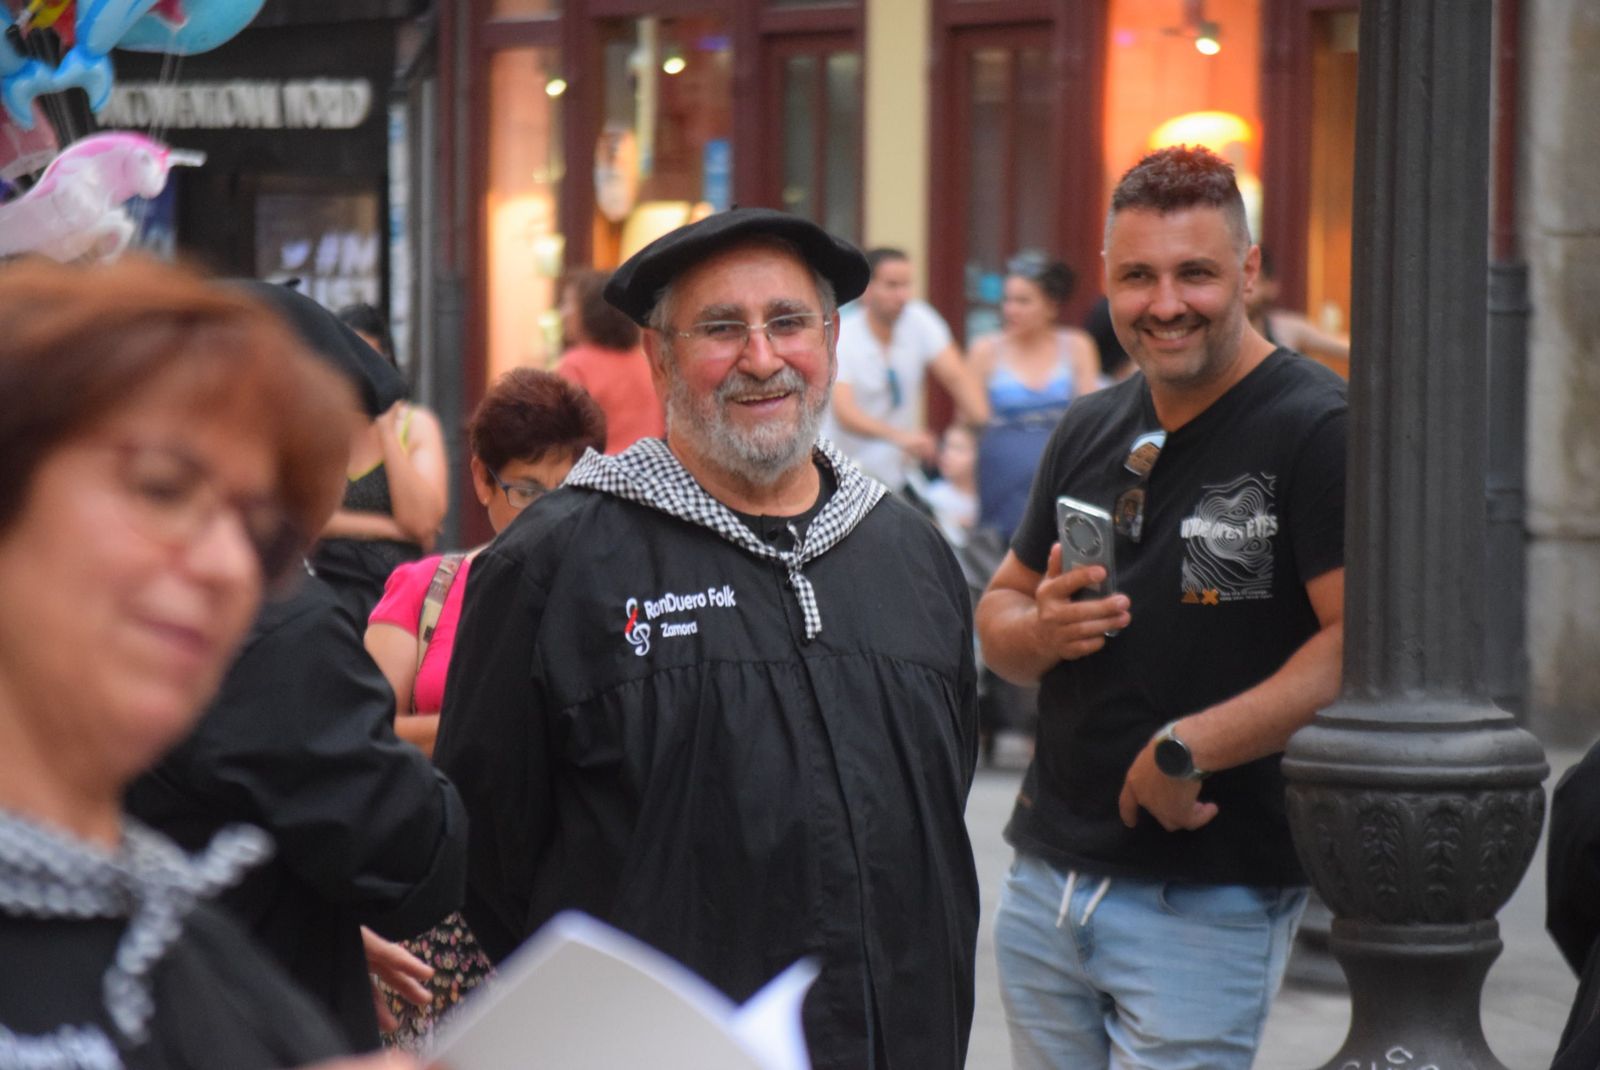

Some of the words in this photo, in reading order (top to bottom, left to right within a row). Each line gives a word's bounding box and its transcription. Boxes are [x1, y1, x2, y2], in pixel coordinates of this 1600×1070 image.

[643, 592, 707, 620] RonDuero
[707, 585, 736, 607] Folk
[660, 621, 698, 638] Zamora
